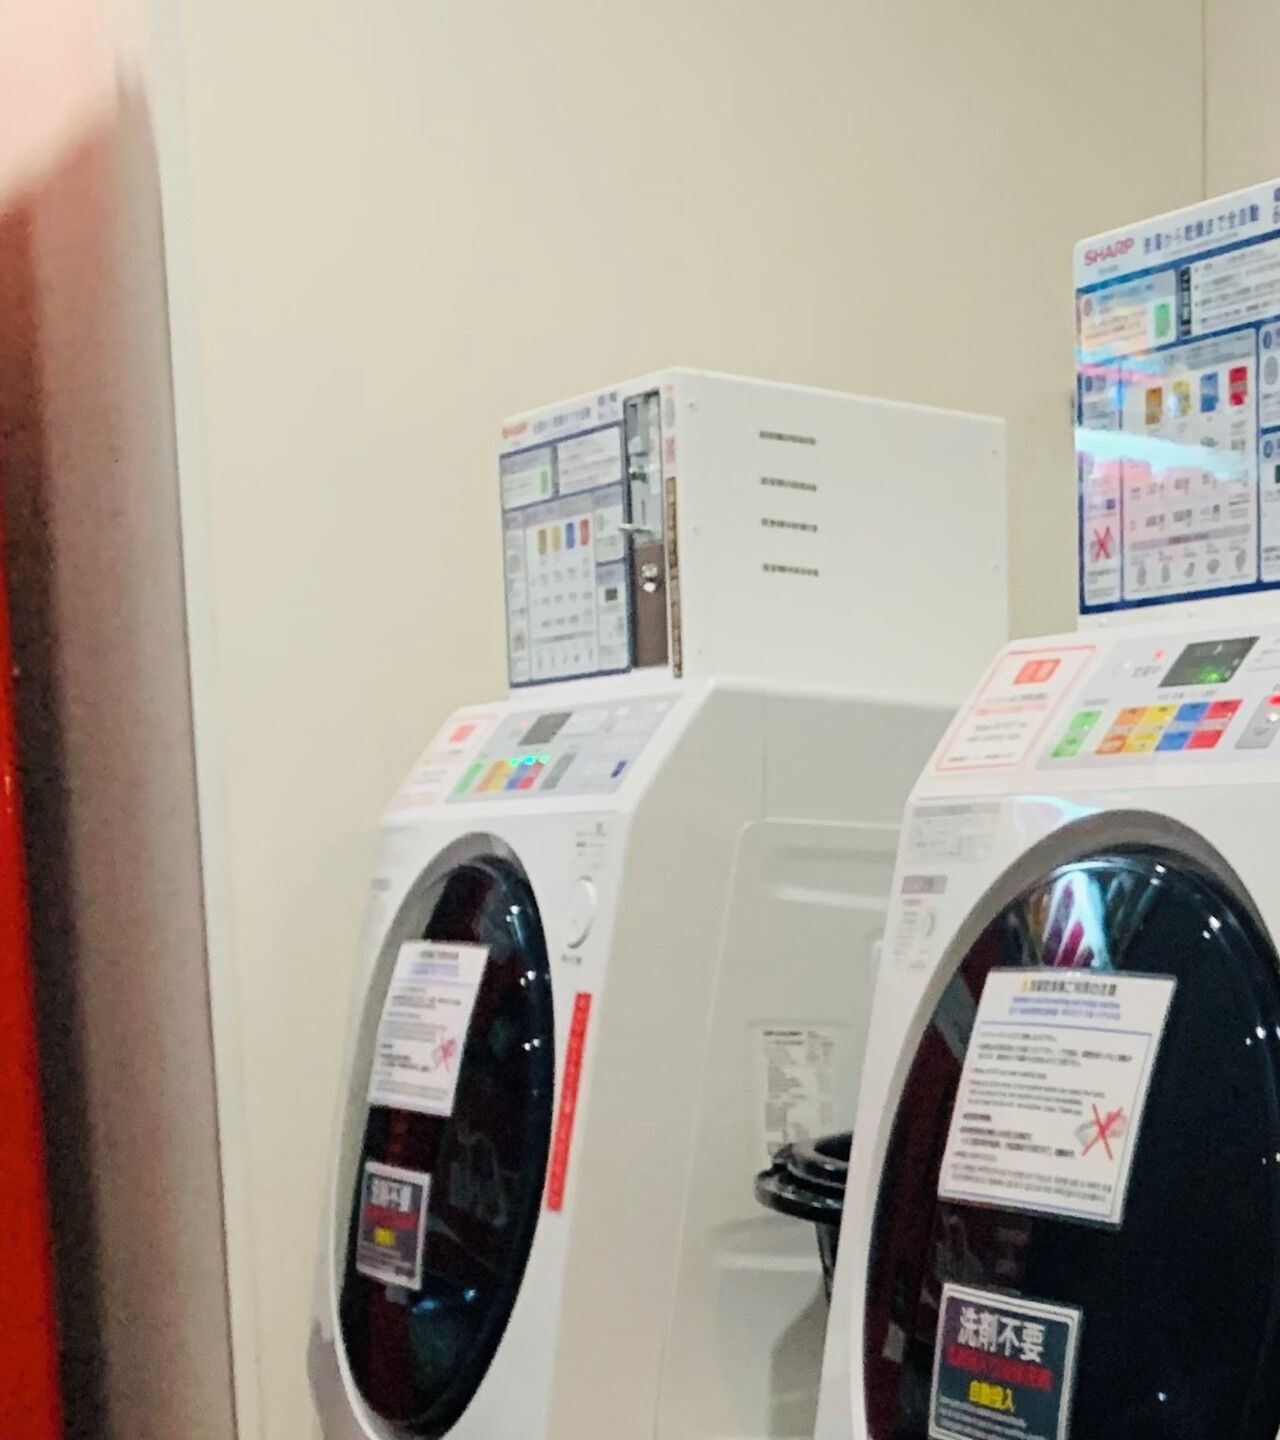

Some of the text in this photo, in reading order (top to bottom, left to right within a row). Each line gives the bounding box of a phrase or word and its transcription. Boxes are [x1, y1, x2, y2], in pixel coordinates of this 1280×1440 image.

[1084, 237, 1135, 266] SHARP
[958, 1306, 1046, 1363] 洗剤不要
